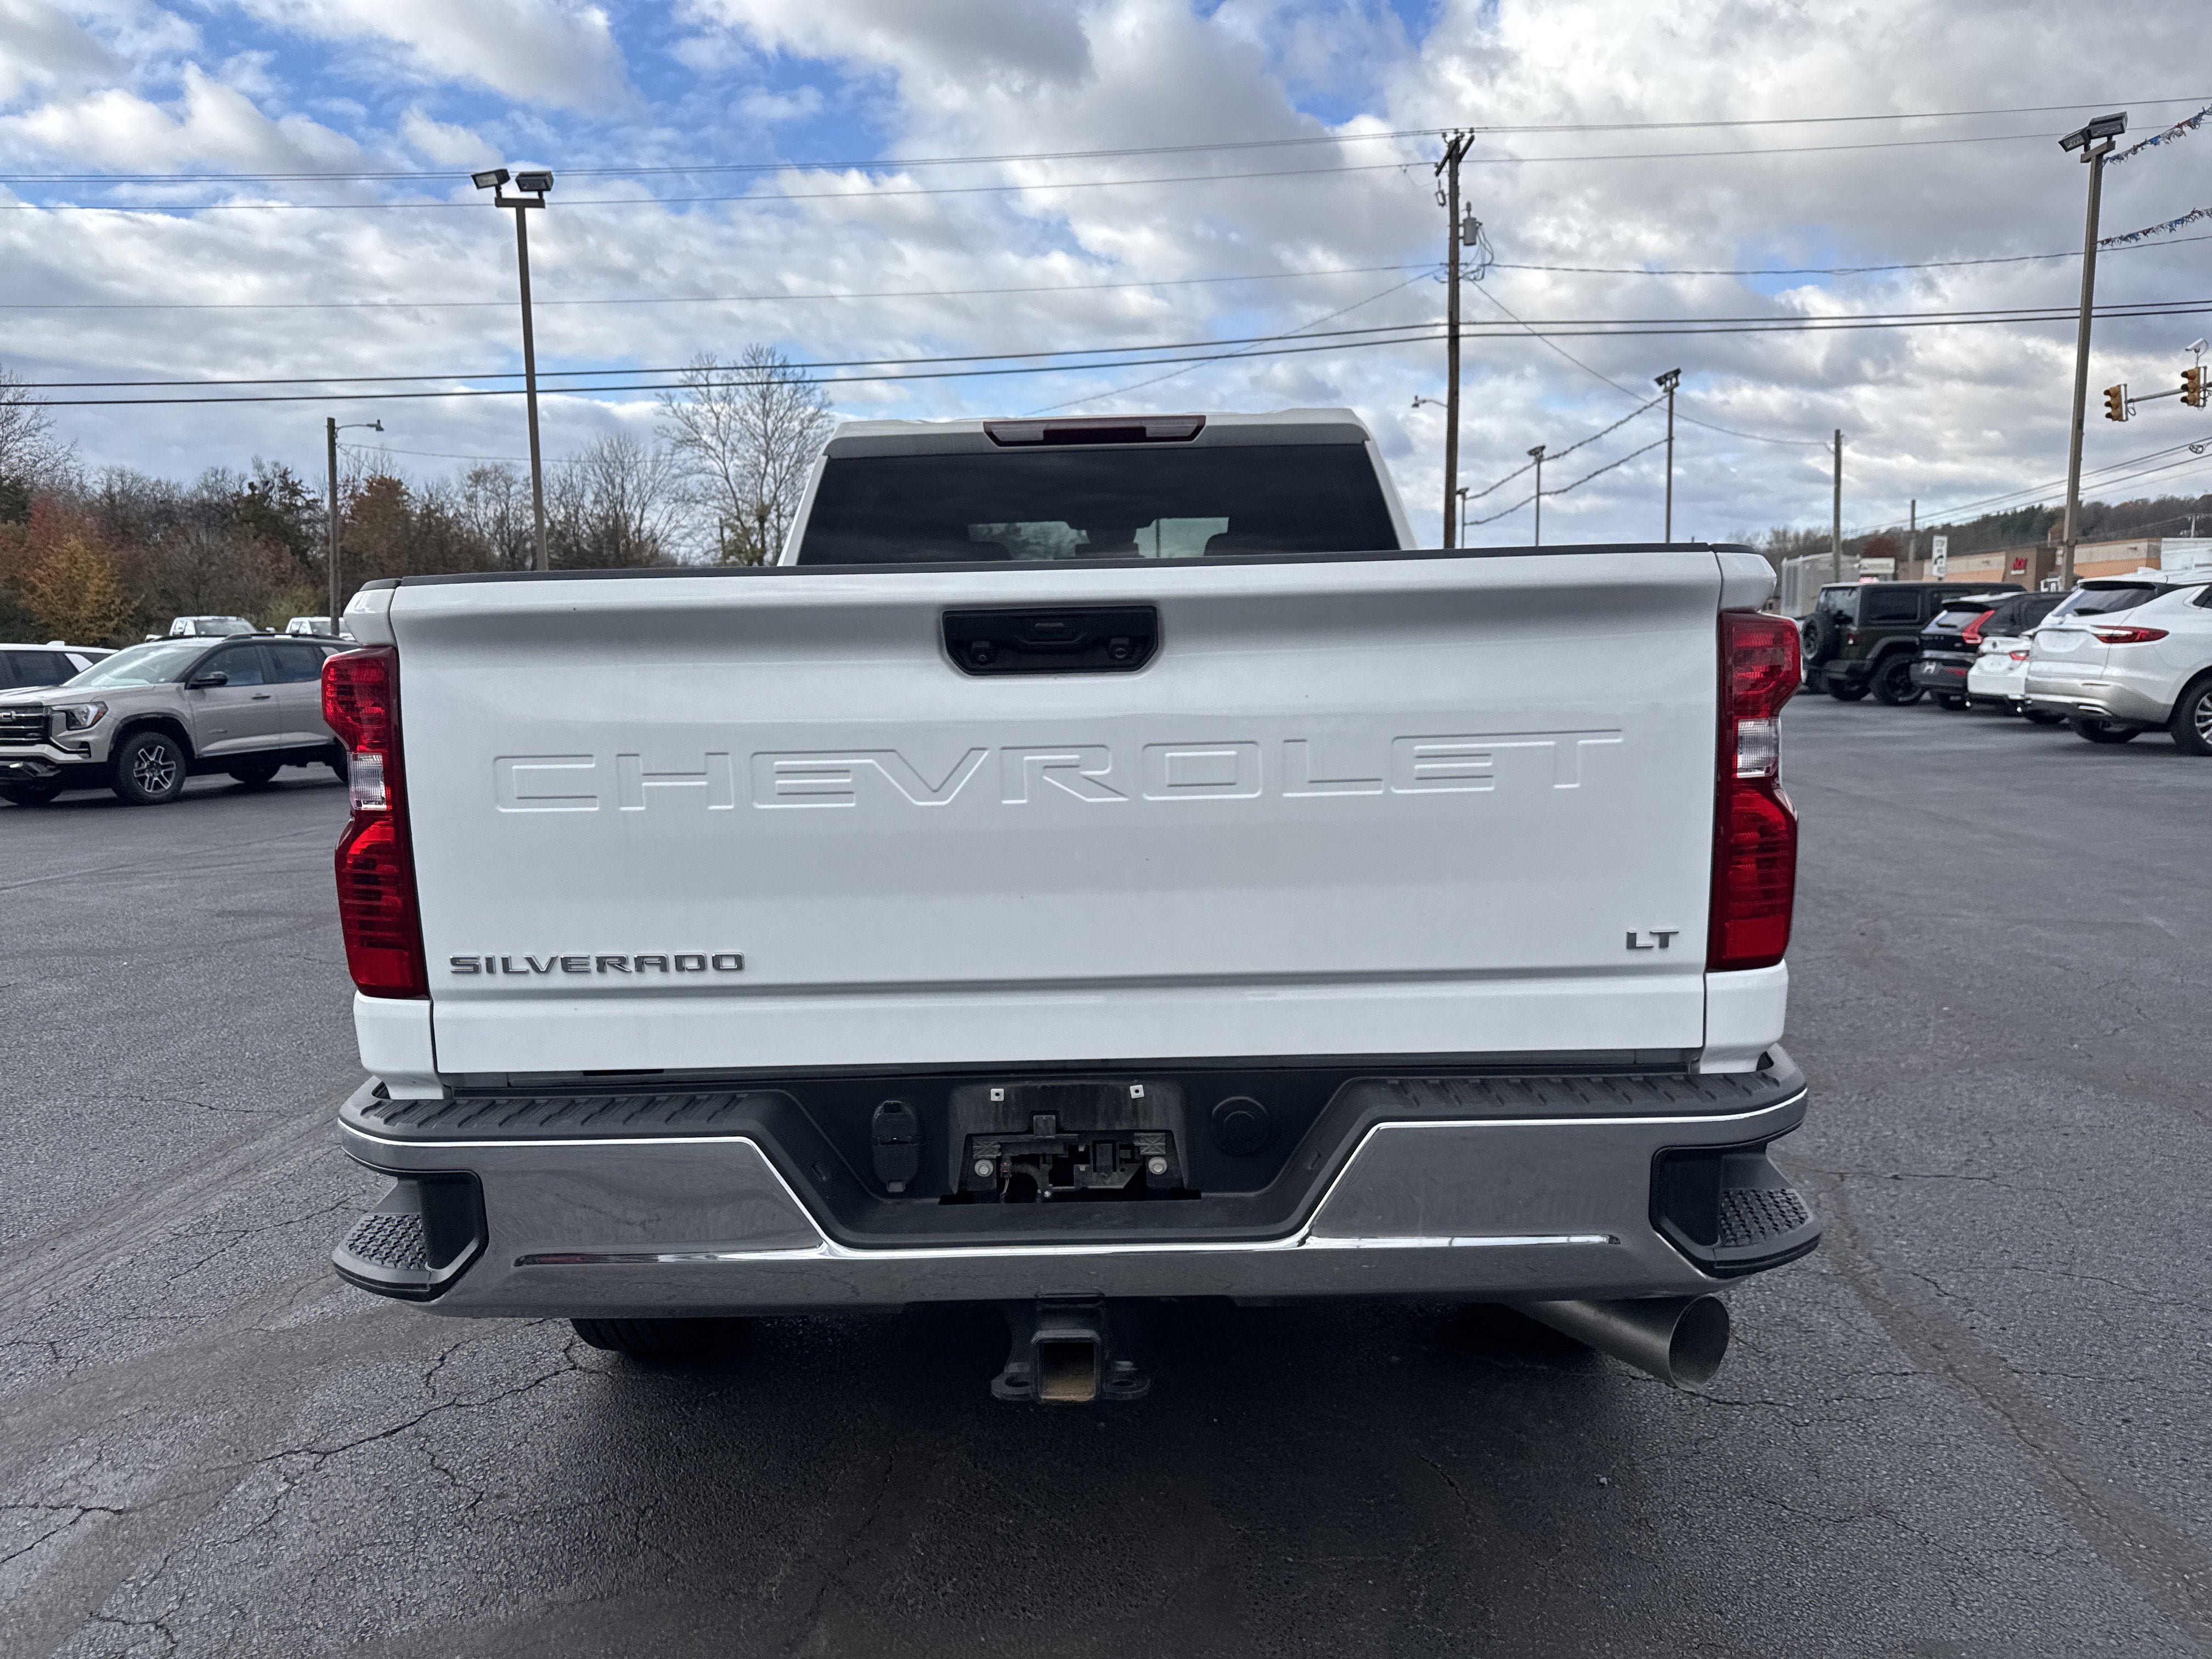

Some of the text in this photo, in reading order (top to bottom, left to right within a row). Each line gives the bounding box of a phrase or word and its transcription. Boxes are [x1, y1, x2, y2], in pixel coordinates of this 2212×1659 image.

[494, 729, 1624, 814] CHEVROLET
[1626, 929, 1680, 950] LT
[449, 952, 746, 974] SILVERADO
